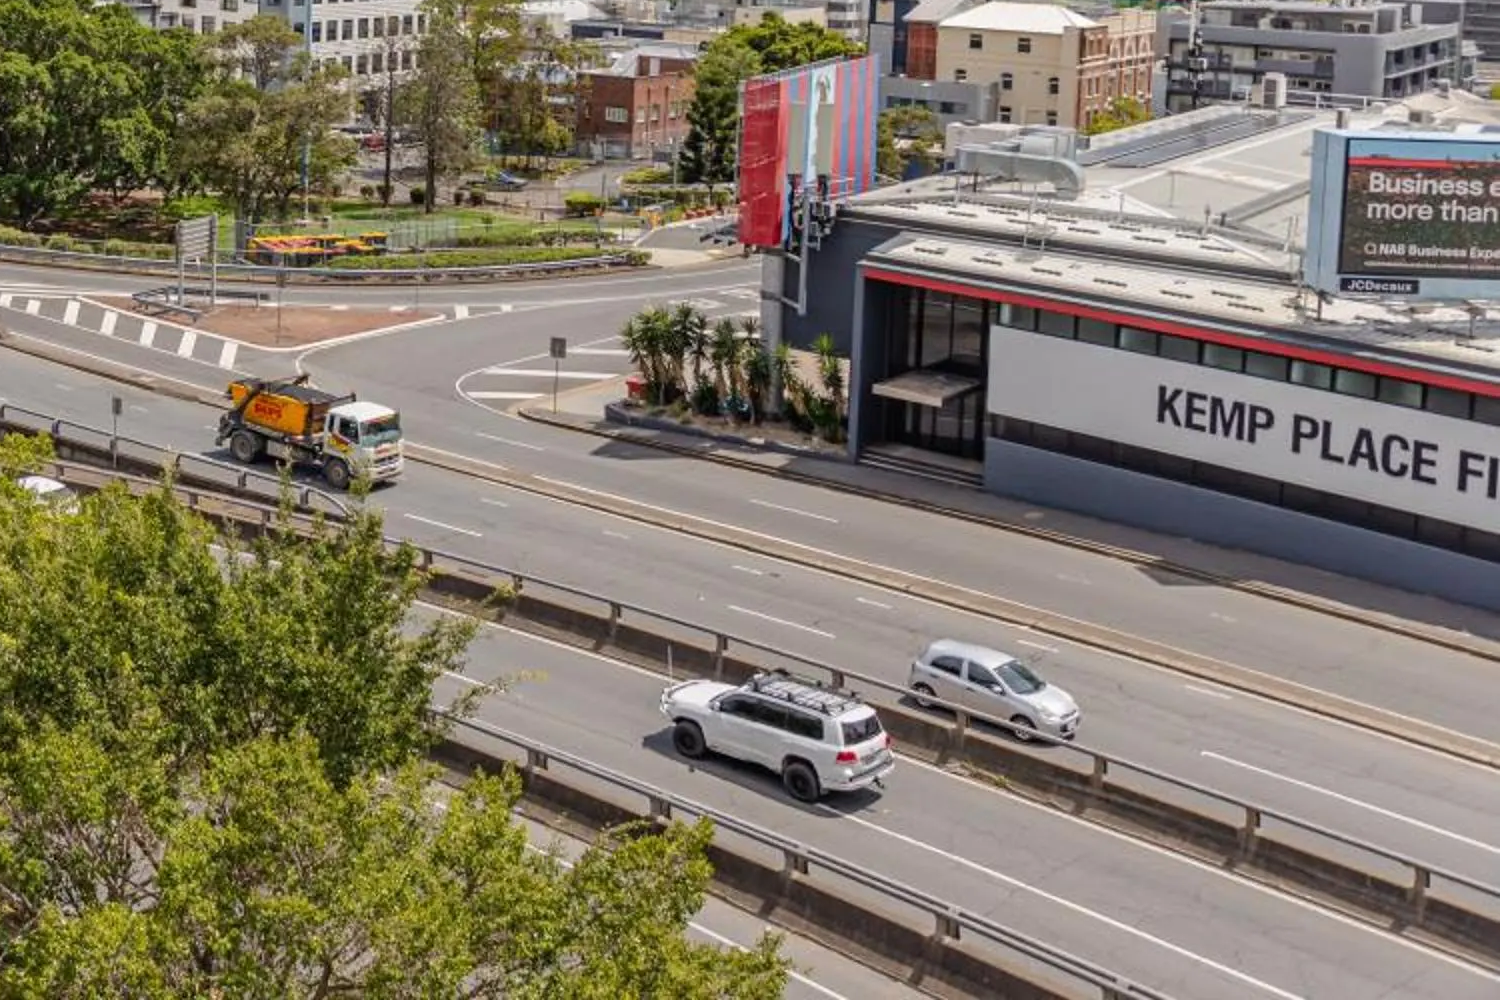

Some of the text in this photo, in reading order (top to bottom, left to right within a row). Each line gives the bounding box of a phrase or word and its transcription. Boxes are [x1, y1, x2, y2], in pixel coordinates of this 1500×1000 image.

[1368, 171, 1485, 196] Business
[1366, 200, 1499, 224] more than
[1379, 242, 1406, 257] NAB
[1408, 243, 1467, 258] Business
[1347, 279, 1413, 292] JCDecaux
[1156, 384, 1499, 500] KEMP PLACE FI
